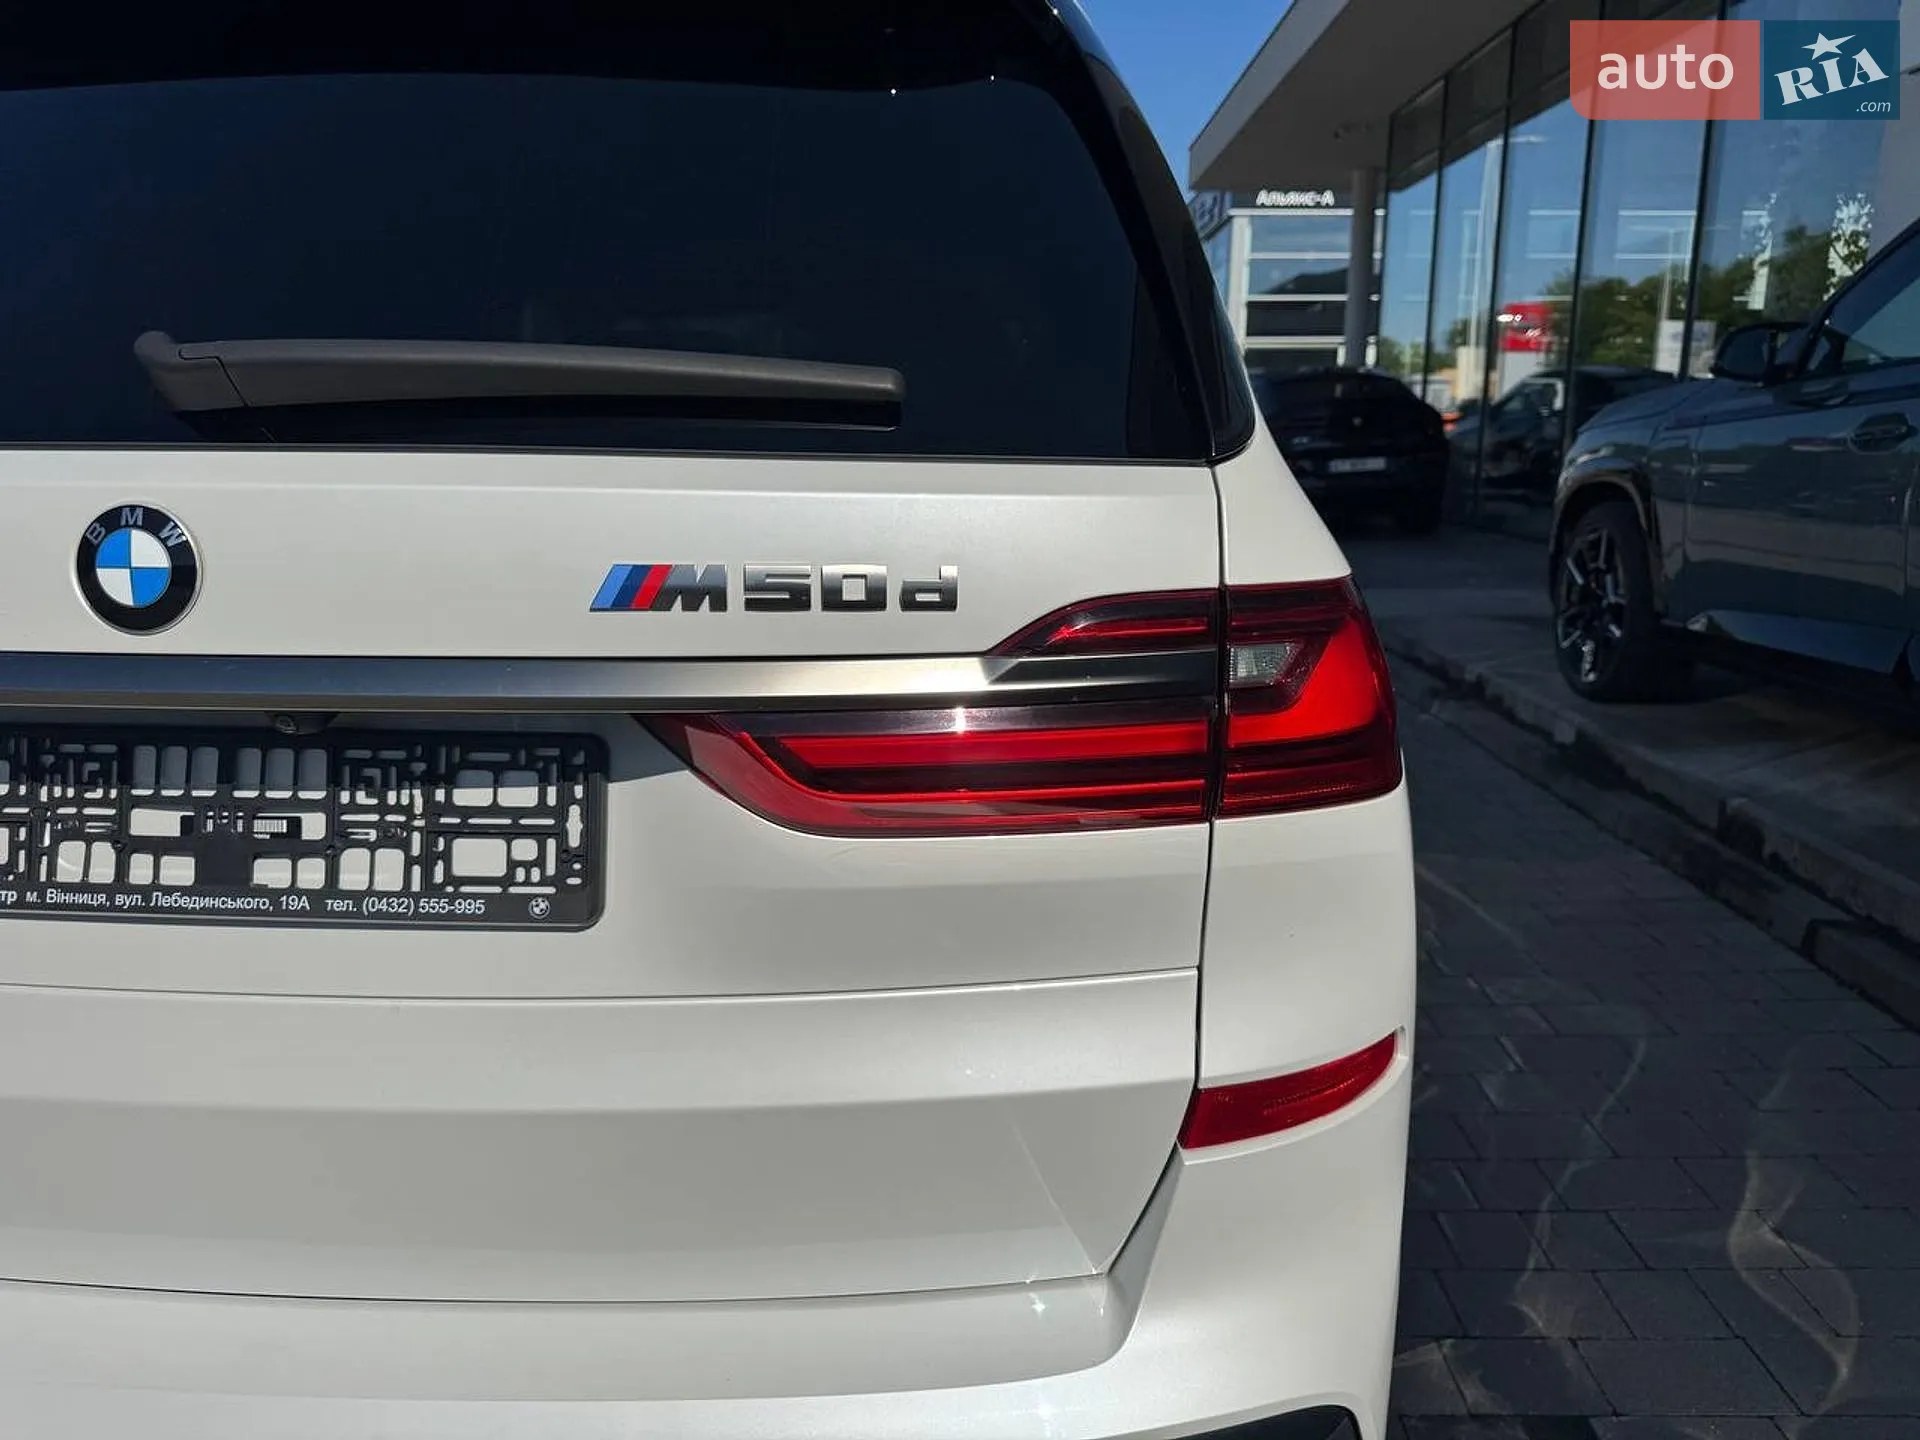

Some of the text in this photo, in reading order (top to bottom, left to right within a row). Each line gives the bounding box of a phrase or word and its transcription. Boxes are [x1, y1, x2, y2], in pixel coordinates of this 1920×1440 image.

[85, 506, 187, 547] BMW
[26, 891, 41, 903] м.
[46, 888, 110, 907] Вінниця,
[115, 893, 145, 908] вул.
[150, 892, 273, 912] Лебединського,
[326, 898, 357, 913] тел.
[362, 897, 415, 916] (0432)
[418, 898, 486, 915] 555-995
